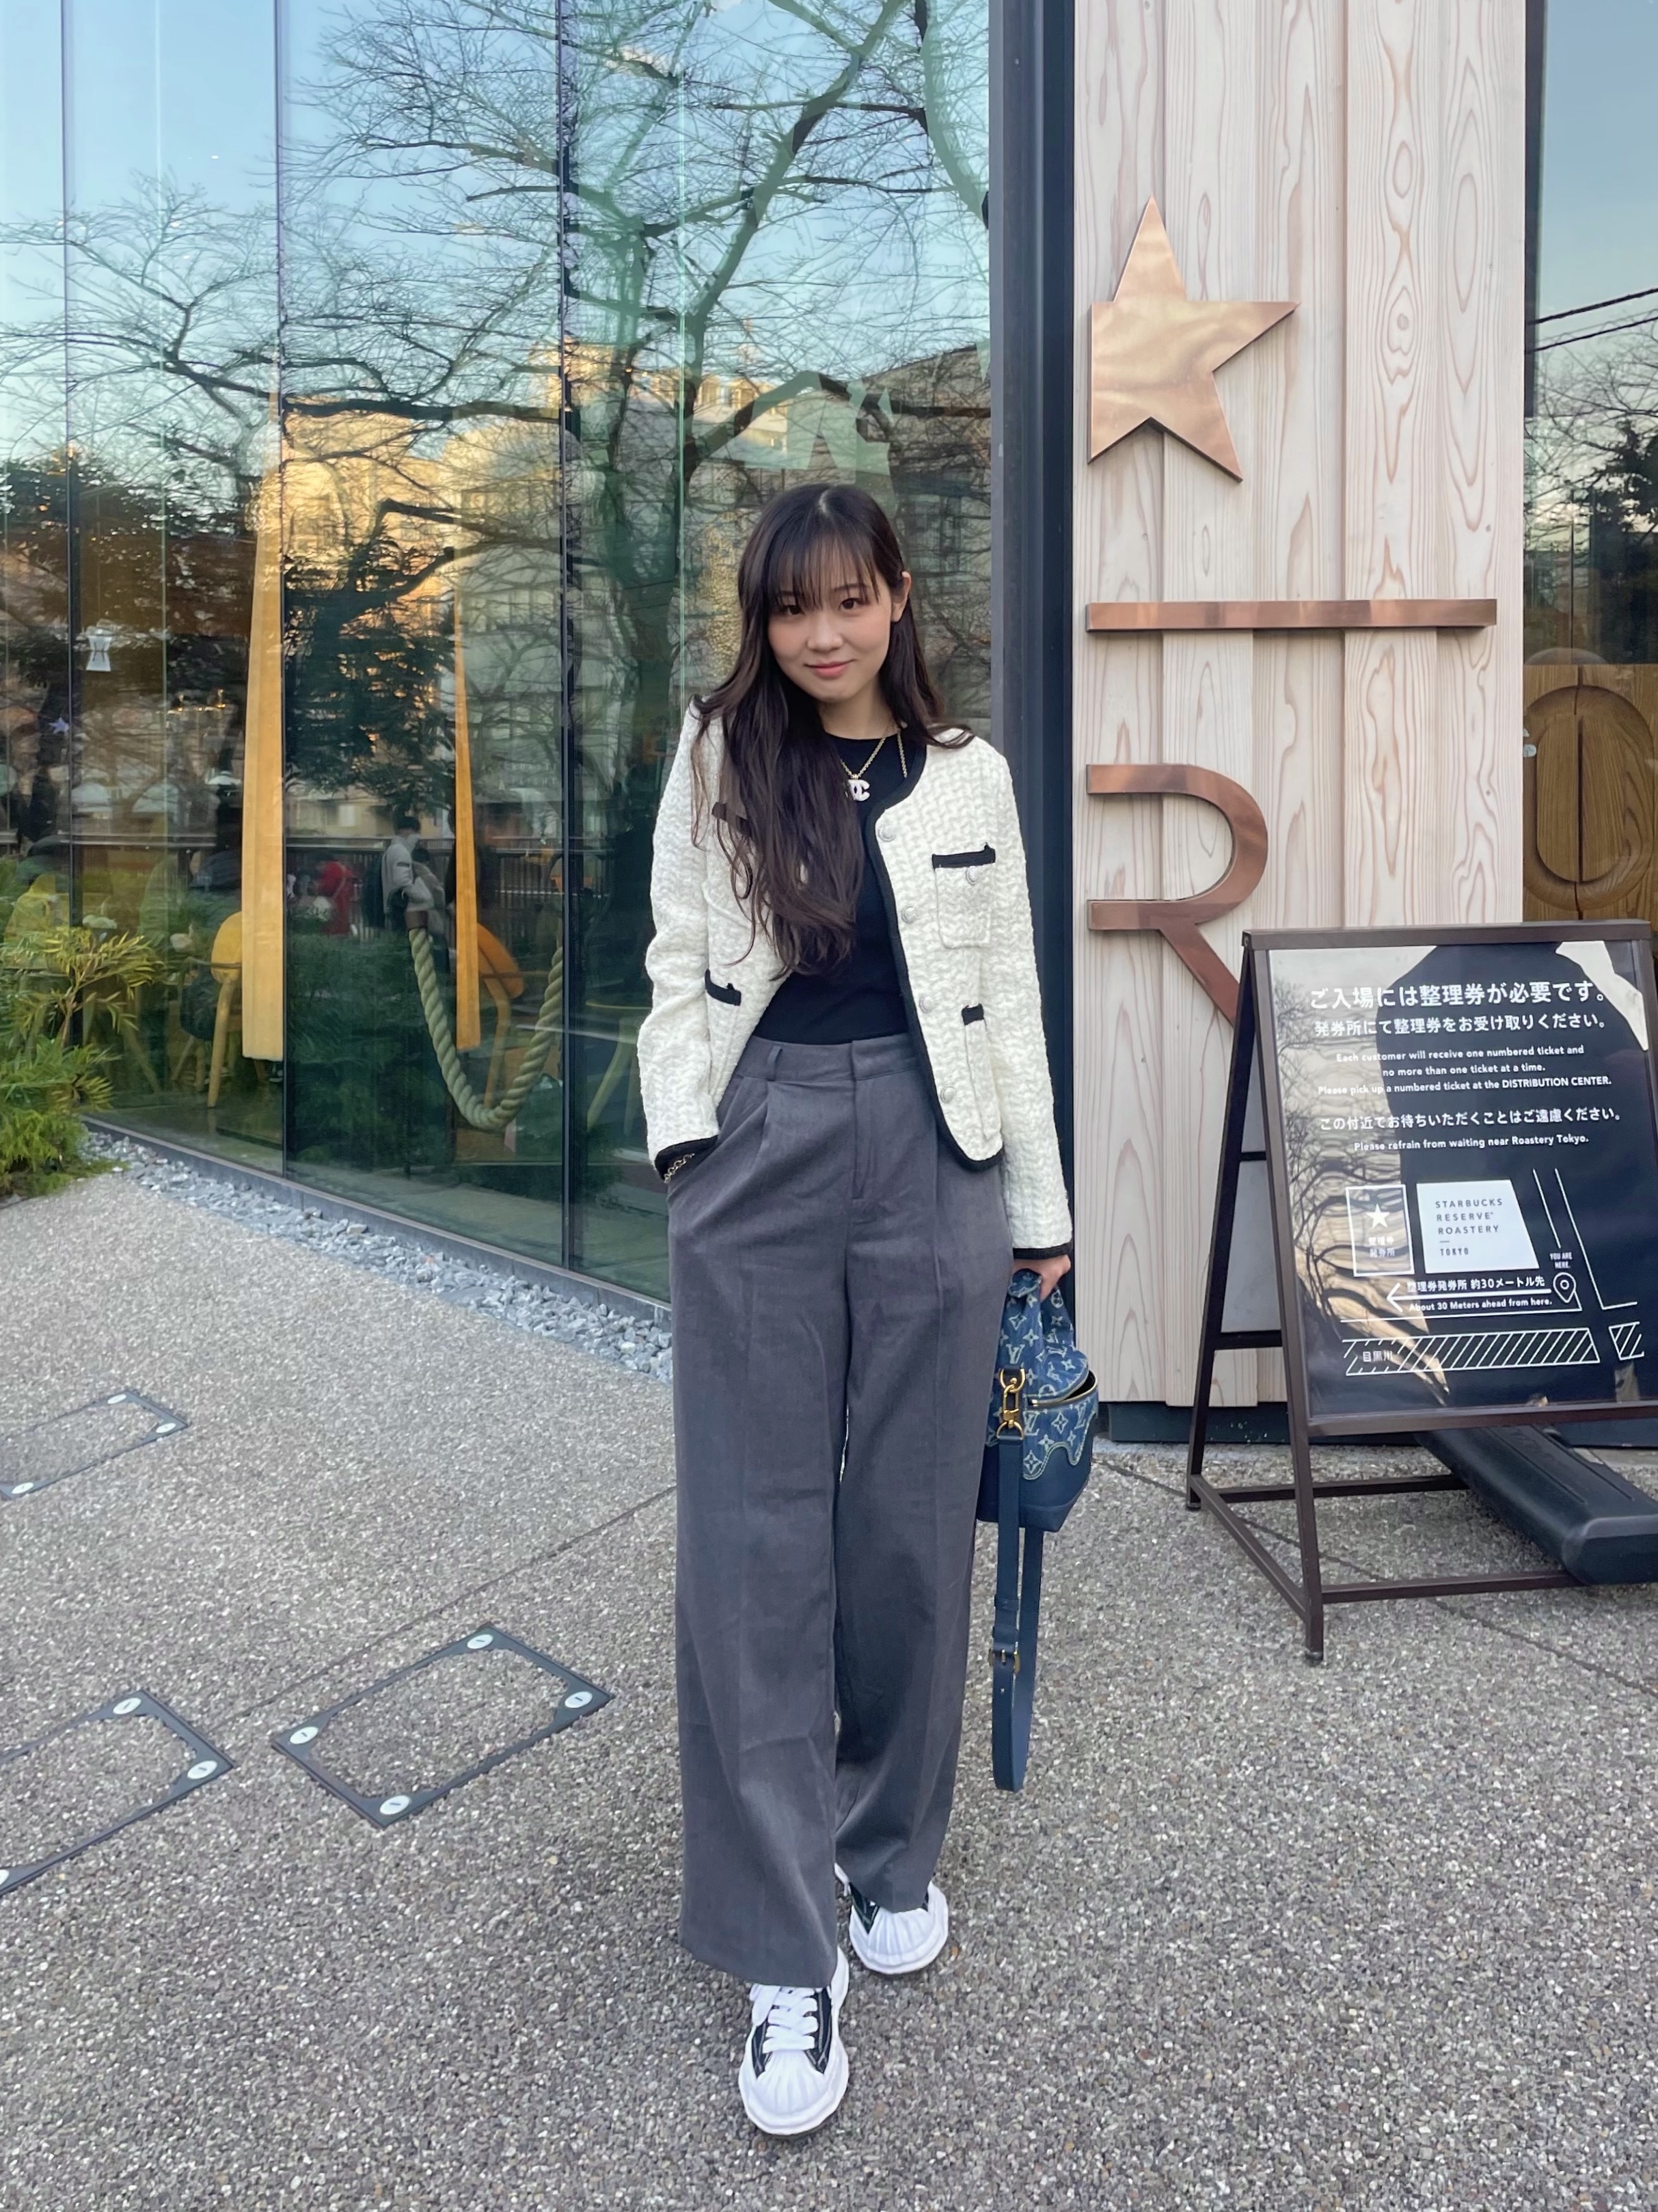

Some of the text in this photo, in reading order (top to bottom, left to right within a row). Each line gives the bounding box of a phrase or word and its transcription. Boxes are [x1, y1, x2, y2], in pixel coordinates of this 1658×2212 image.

[1086, 764, 1268, 1029] R
[1311, 980, 1604, 1009] ご入場には整理券が必要です。
[1314, 1012, 1605, 1037] 発券所にて整理券をお受け取りください。
[1336, 1053, 1359, 1062] Each
[1361, 1053, 1406, 1061] customer
[1409, 1050, 1426, 1060] will
[1428, 1049, 1463, 1060] receive
[1486, 1046, 1534, 1057] numbered
[1537, 1045, 1564, 1055] ticket
[1566, 1044, 1584, 1054] and
[1398, 1068, 1422, 1076] more
[1425, 1066, 1447, 1075] than
[1470, 1064, 1498, 1074] ticket
[1501, 1064, 1510, 1073] at
[1521, 1062, 1545, 1072] time.
[1318, 1086, 1347, 1094] Please
[1350, 1085, 1369, 1096] pick
[1372, 1086, 1384, 1094] up
[1394, 1081, 1441, 1092] numbered
[1443, 1080, 1470, 1090] ticket
[1472, 1079, 1482, 1089] at
[1484, 1078, 1499, 1088] the
[1501, 1077, 1568, 1088] DISTRIBUTION
[1571, 1075, 1612, 1086] CENTER.
[1354, 1134, 1589, 1151] Please refrain from waiting near Roastery Tokyo.
[1435, 1198, 1502, 1209] STARBUCKS
[1438, 1225, 1499, 1235] ROASTERY
[1440, 1247, 1469, 1256] TOKYO
[1409, 1297, 1552, 1311] About 30 Meters ahead from here.
